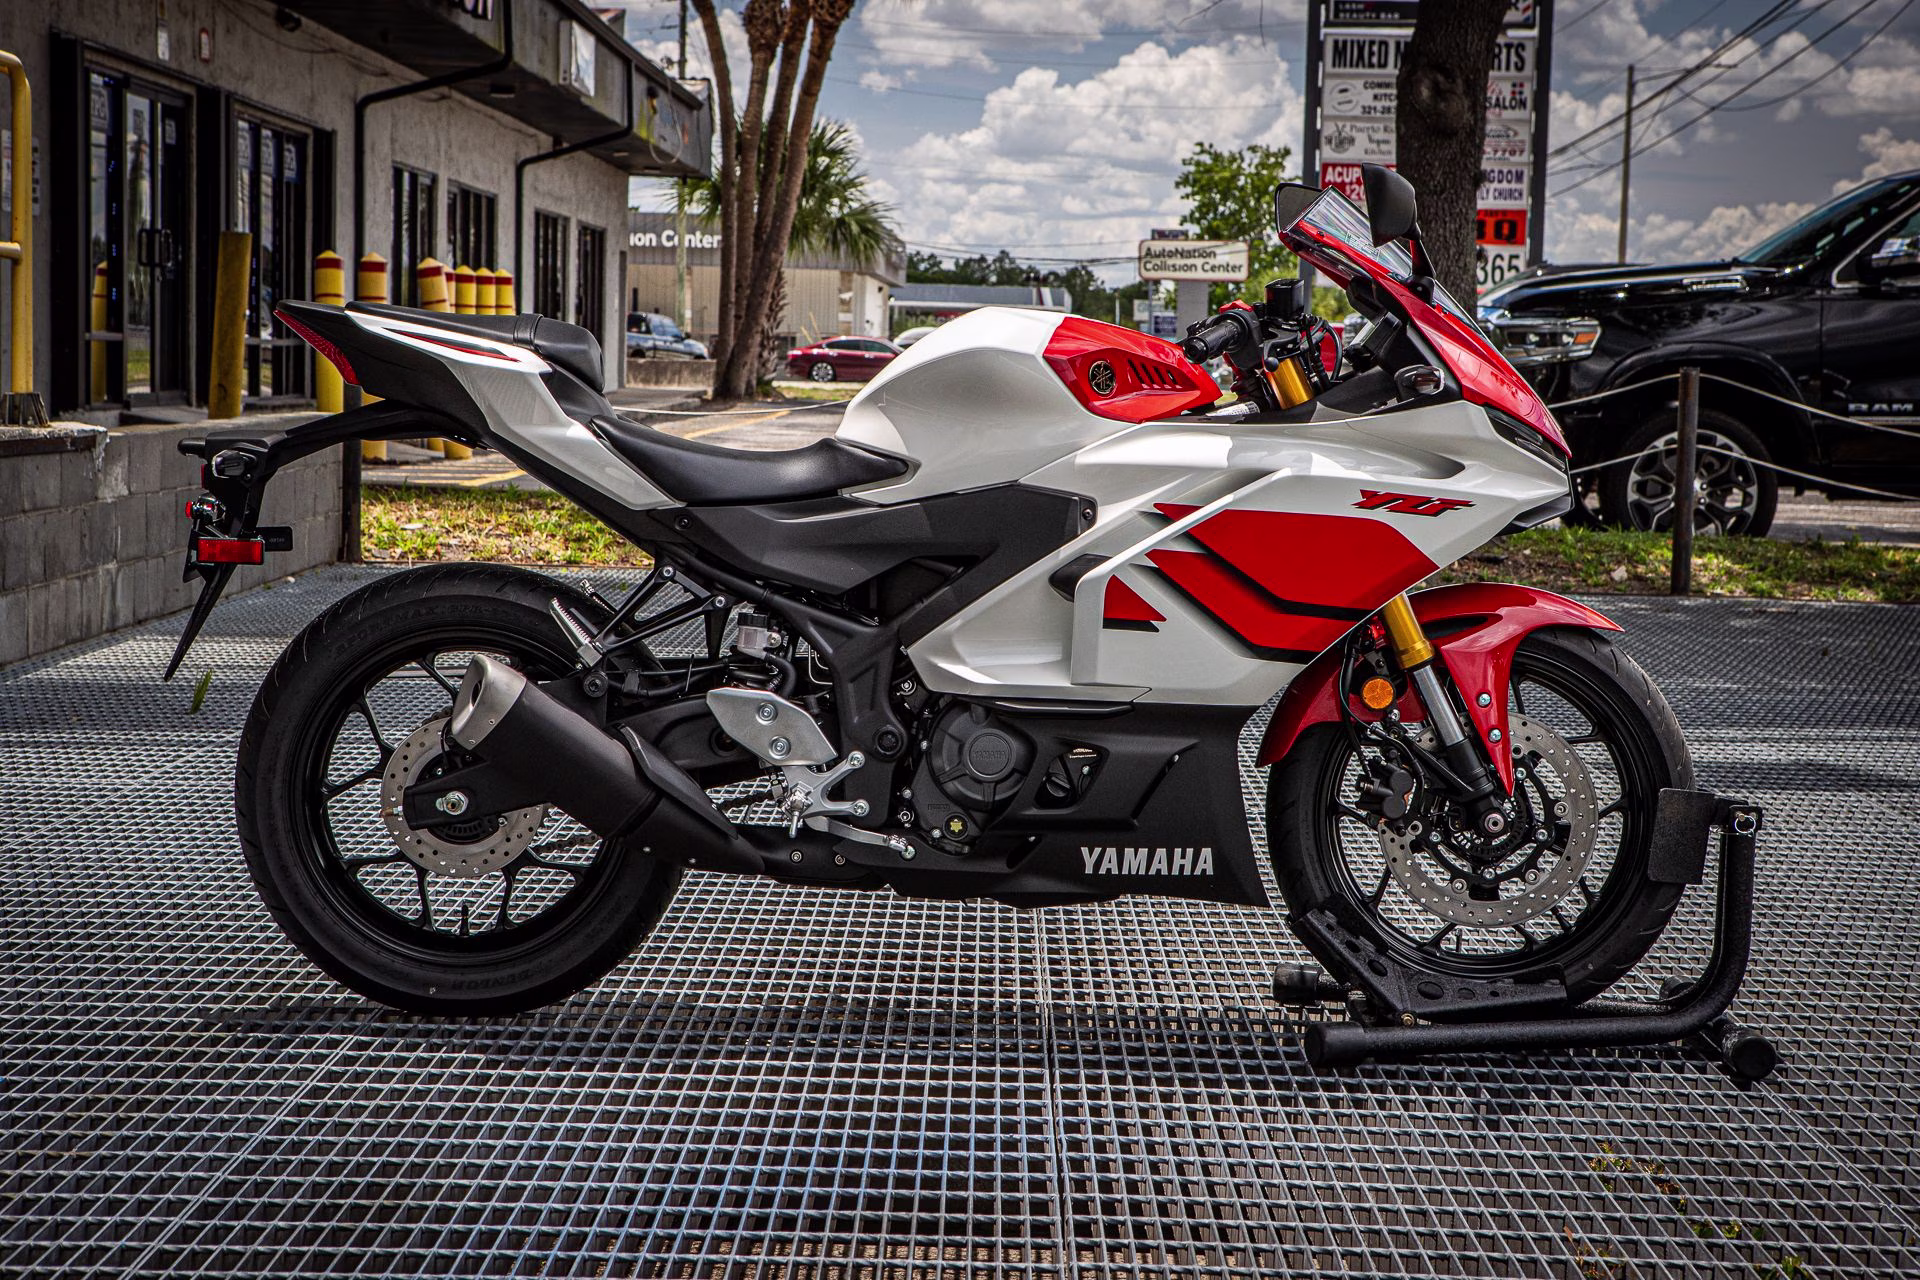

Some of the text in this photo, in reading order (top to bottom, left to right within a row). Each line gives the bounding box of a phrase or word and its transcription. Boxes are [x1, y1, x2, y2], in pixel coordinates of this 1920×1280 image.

[1332, 39, 1389, 69] MIXED
[1491, 42, 1526, 73] RTS
[1373, 93, 1398, 102] KITC
[1484, 96, 1527, 111] SALON
[1324, 166, 1362, 183] ACUP
[1493, 188, 1523, 201] CHURCH
[629, 232, 657, 247] ion
[1145, 246, 1217, 259] AutoNation
[1143, 261, 1243, 274] Collision Center
[1848, 403, 1914, 412] RAM
[1080, 846, 1214, 876] YAMAHA
